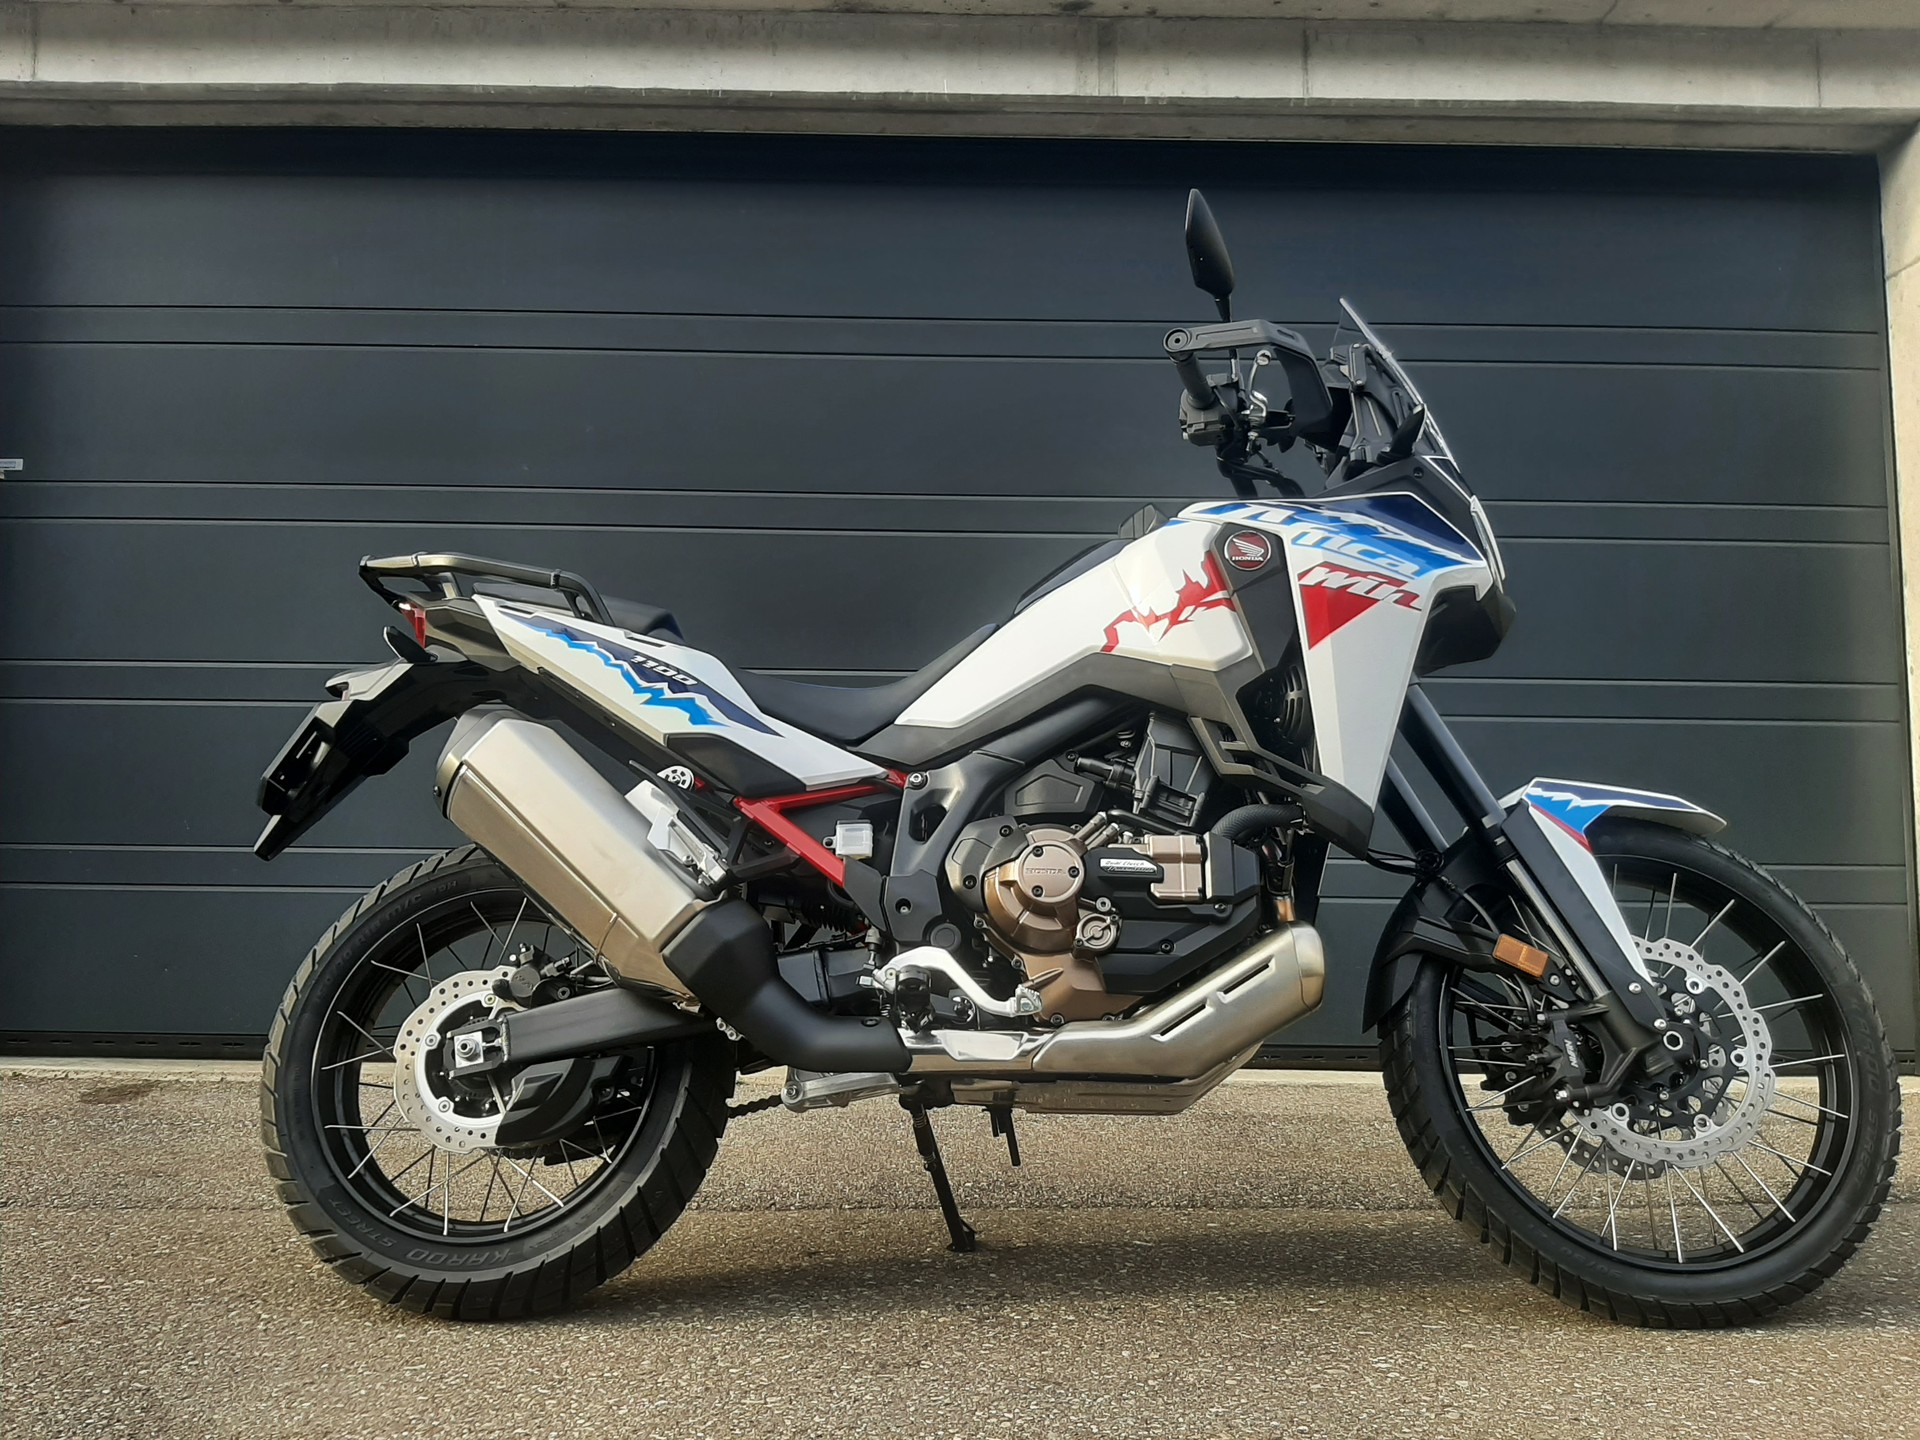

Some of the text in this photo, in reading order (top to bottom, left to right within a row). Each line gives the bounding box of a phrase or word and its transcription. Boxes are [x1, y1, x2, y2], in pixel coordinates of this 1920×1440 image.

[631, 655, 698, 686] 1100
[329, 1199, 511, 1266] KAROO STREET
